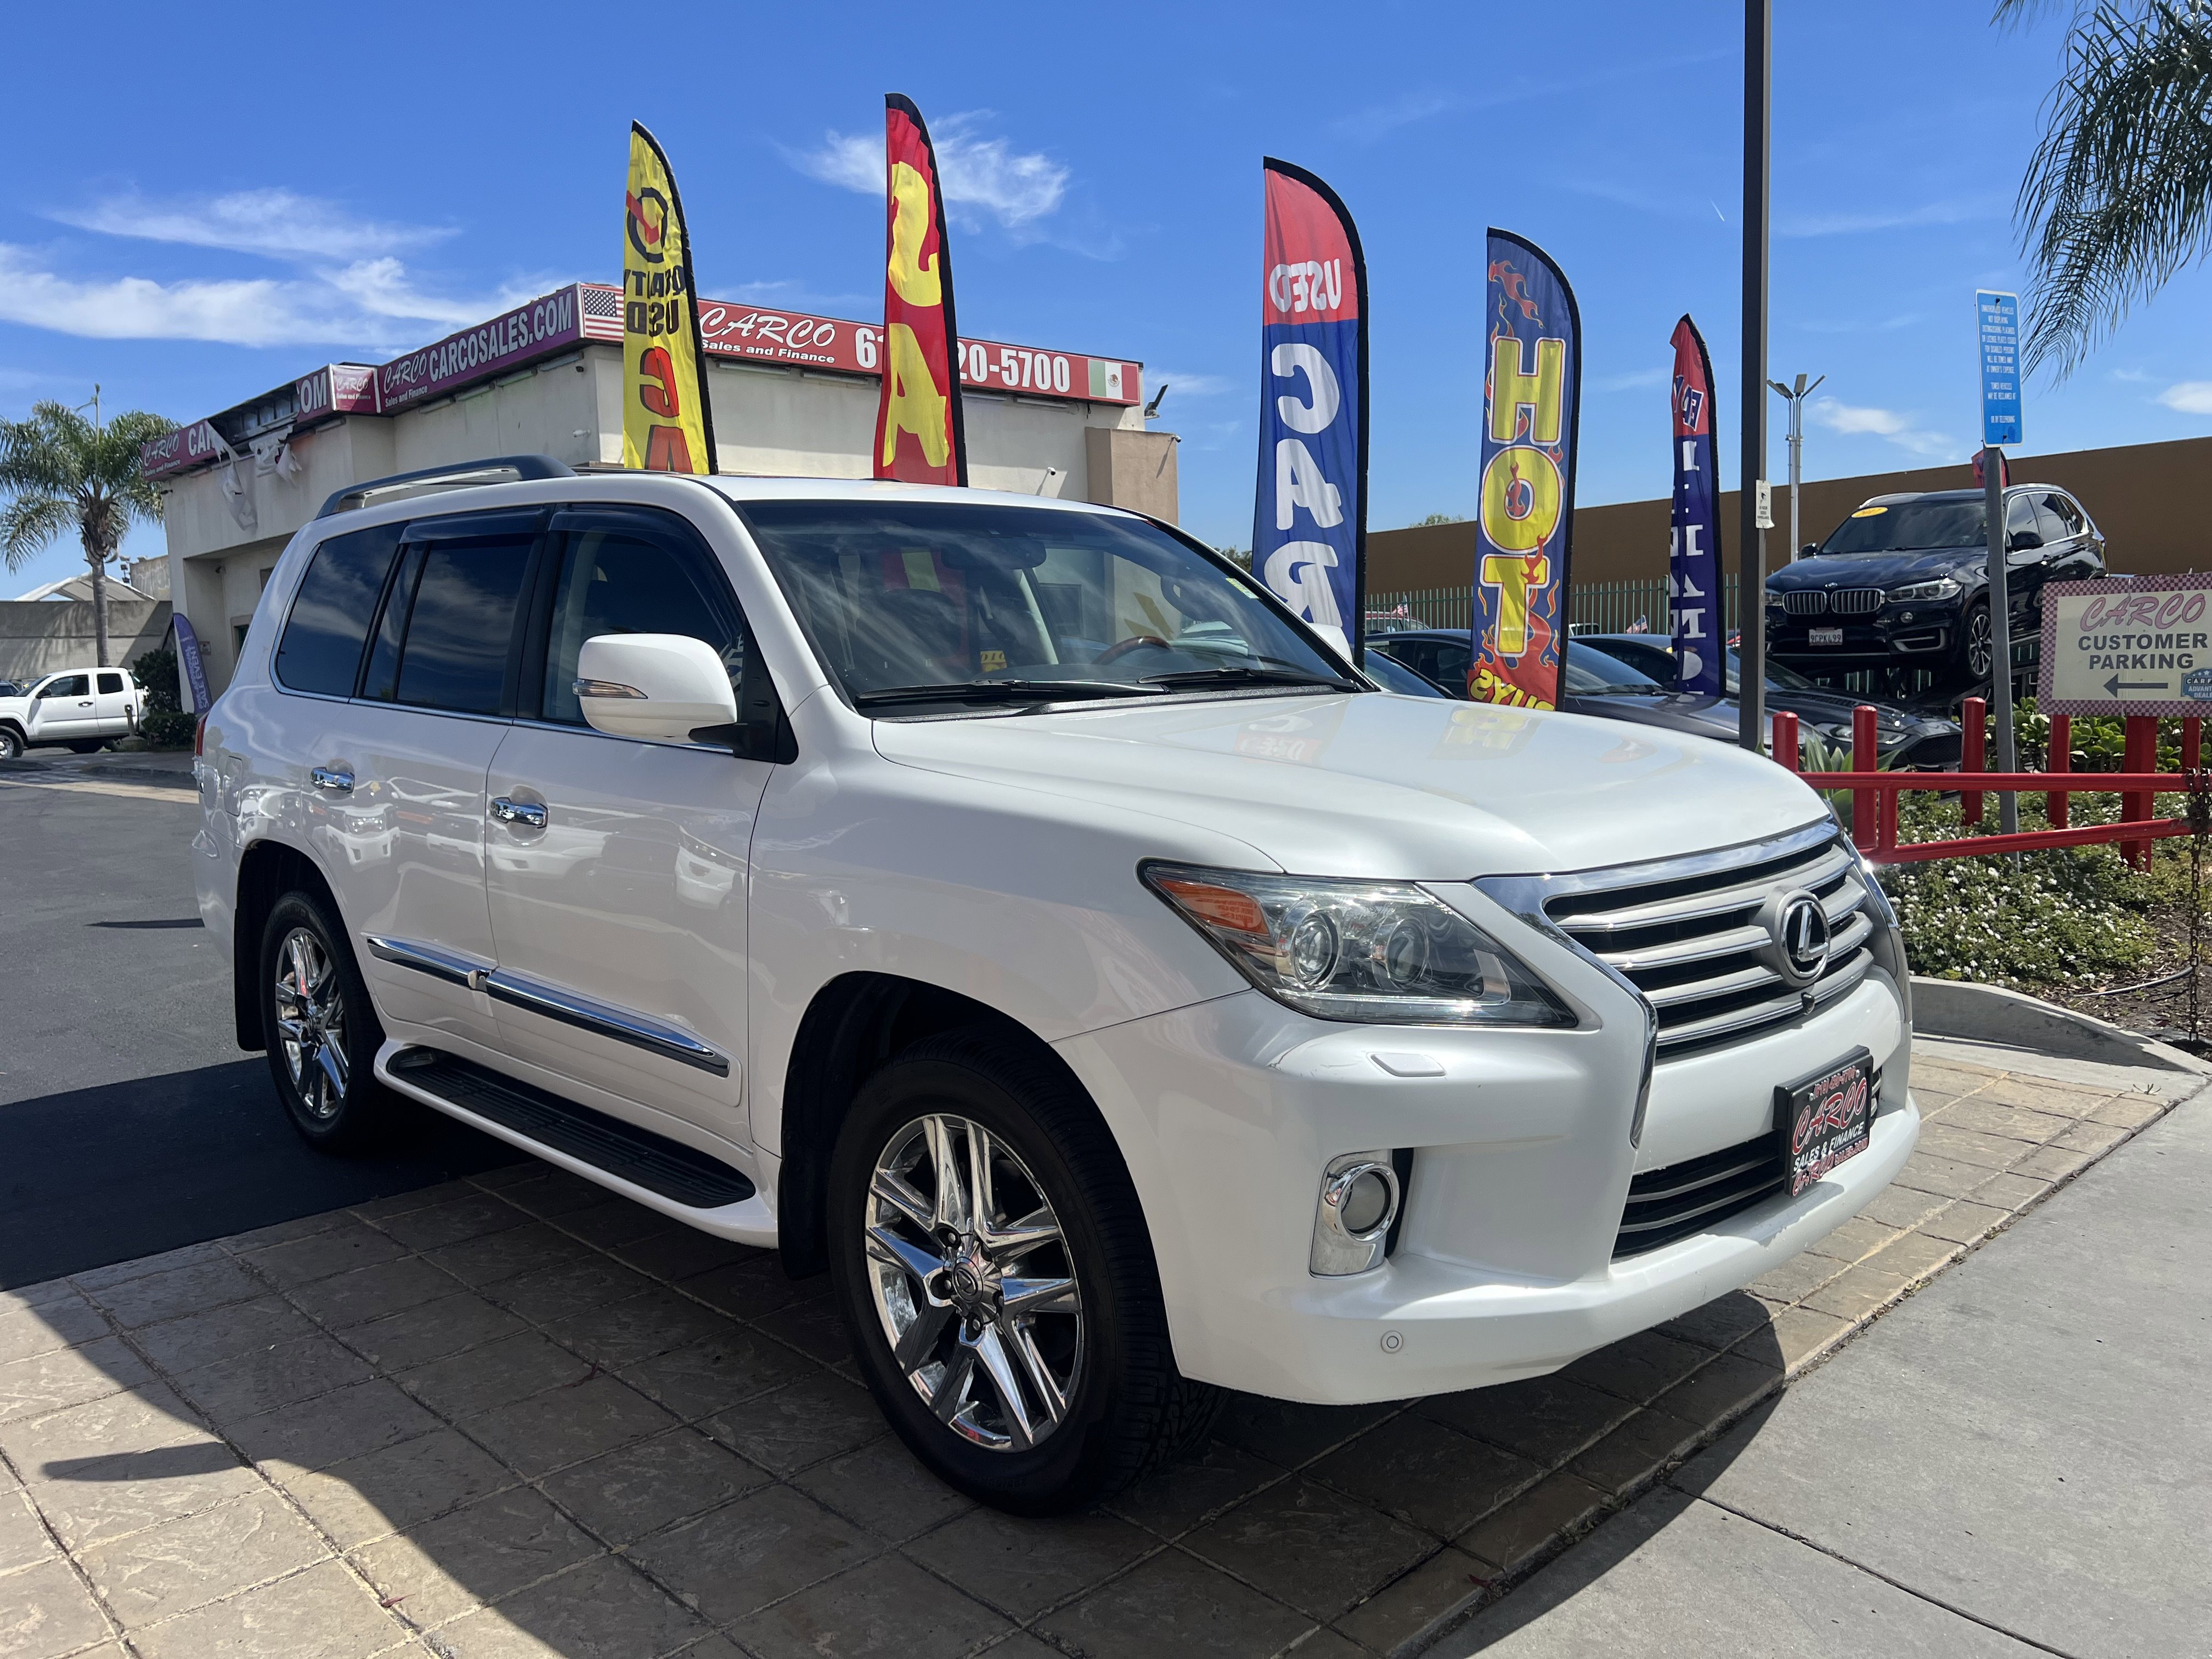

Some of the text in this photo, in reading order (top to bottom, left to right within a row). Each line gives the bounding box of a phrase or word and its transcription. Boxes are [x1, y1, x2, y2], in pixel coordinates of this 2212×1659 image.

[384, 292, 572, 394] CARCO CARCOSALES.COM
[699, 307, 836, 348] CARCO
[702, 339, 835, 364] Sales and Finance
[336, 377, 369, 392] CARCO
[385, 385, 427, 408] Sales and Finance
[144, 433, 179, 467] CARCO
[297, 372, 327, 414] OM
[2080, 593, 2206, 631] CARCO
[2078, 633, 2208, 651] CUSTOMER
[2089, 653, 2193, 670] PARKING
[1792, 1077, 1867, 1155] CARCO
[1793, 1121, 1865, 1172] SALES & FINANCE
